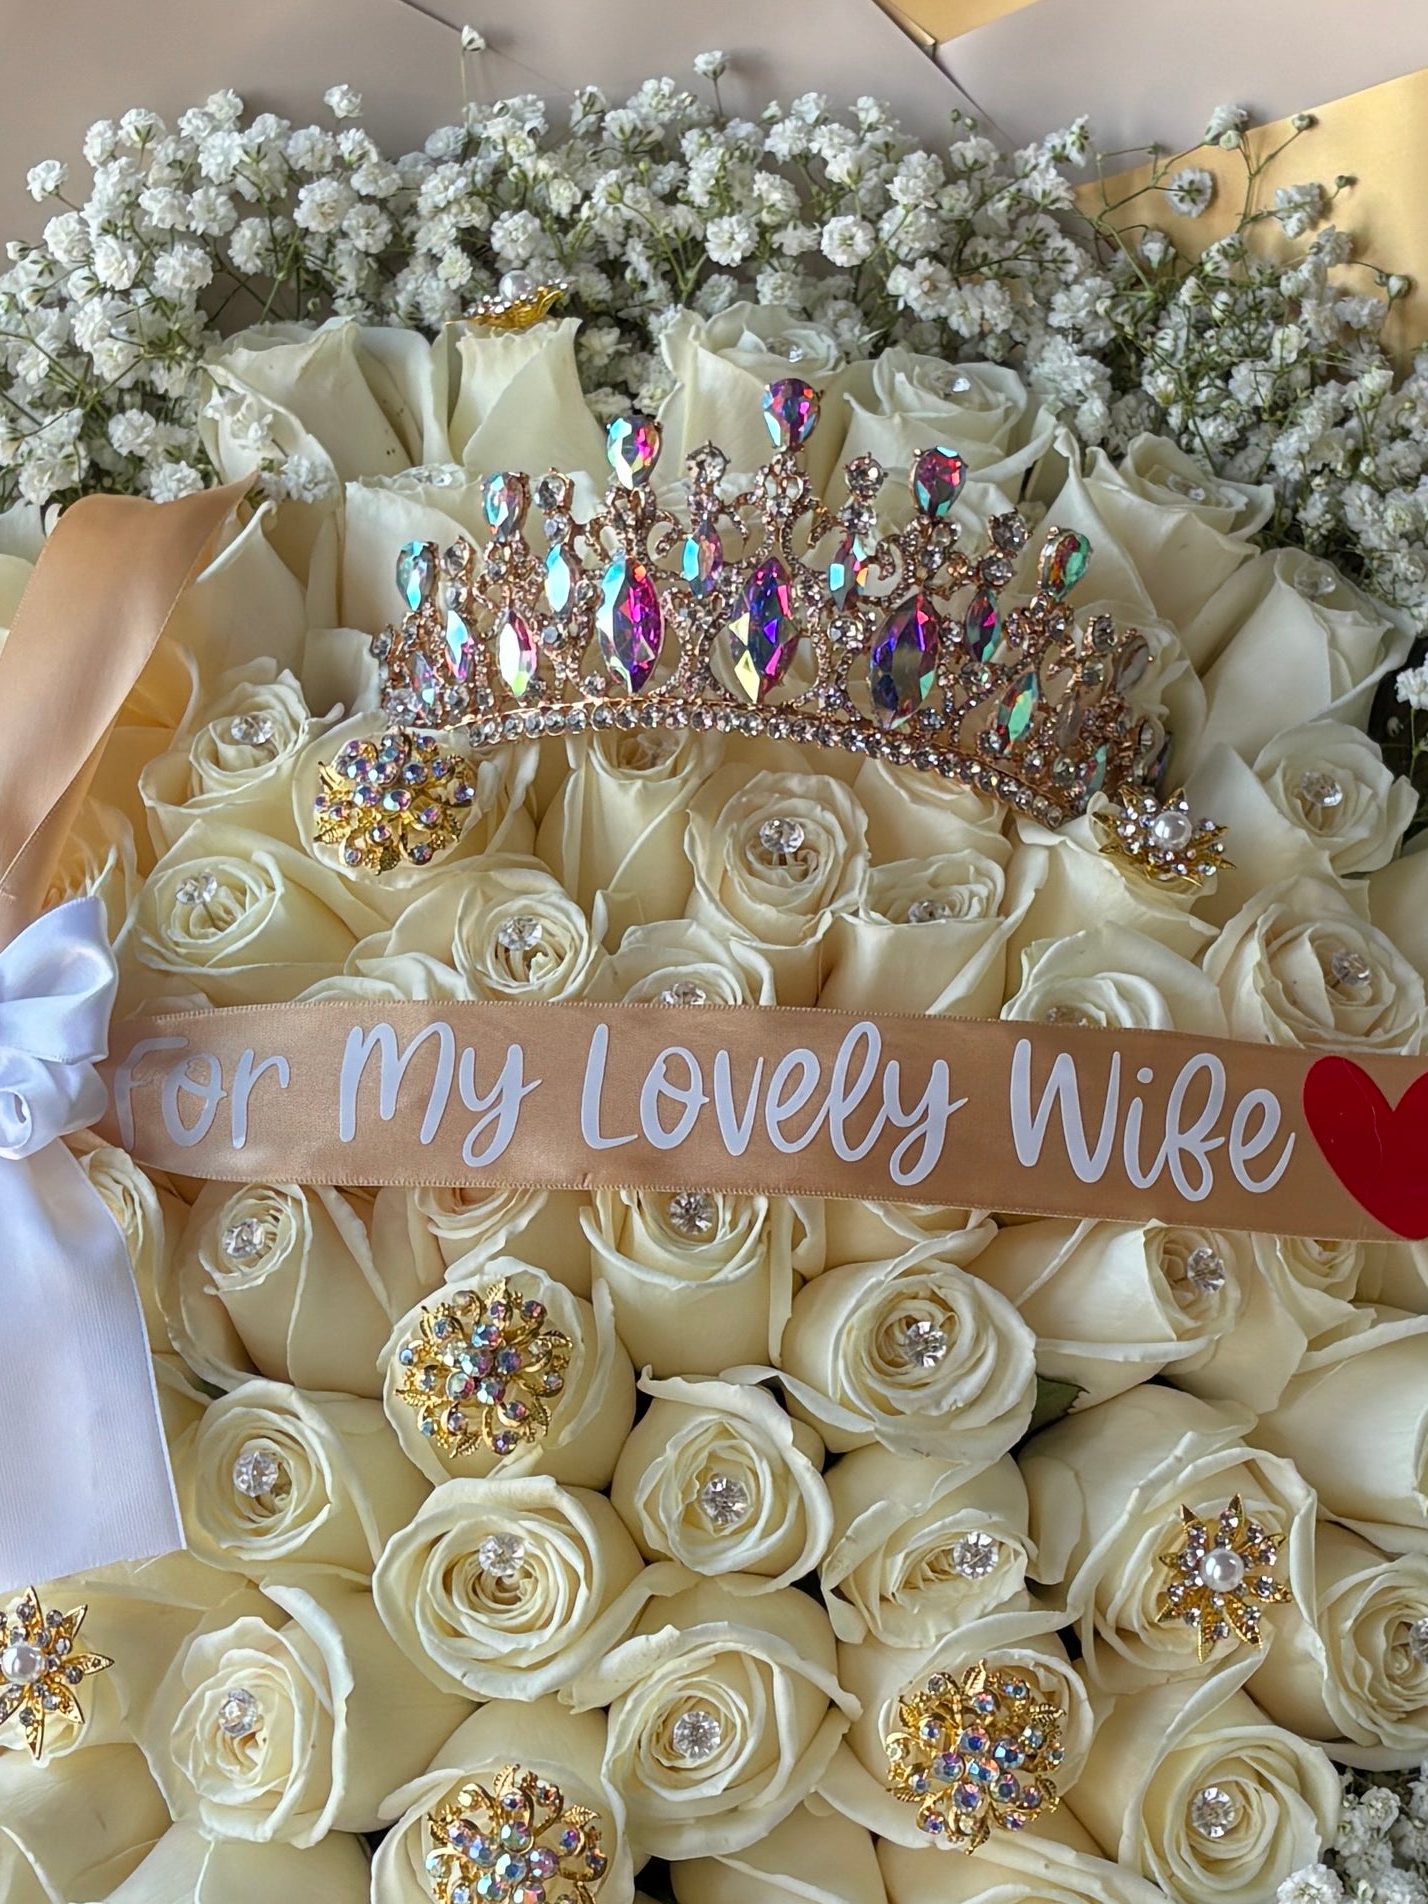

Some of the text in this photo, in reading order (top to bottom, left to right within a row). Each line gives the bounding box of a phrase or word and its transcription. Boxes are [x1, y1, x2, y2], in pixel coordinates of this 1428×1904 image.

[113, 1021, 1297, 1203] For My Lovely Wife
